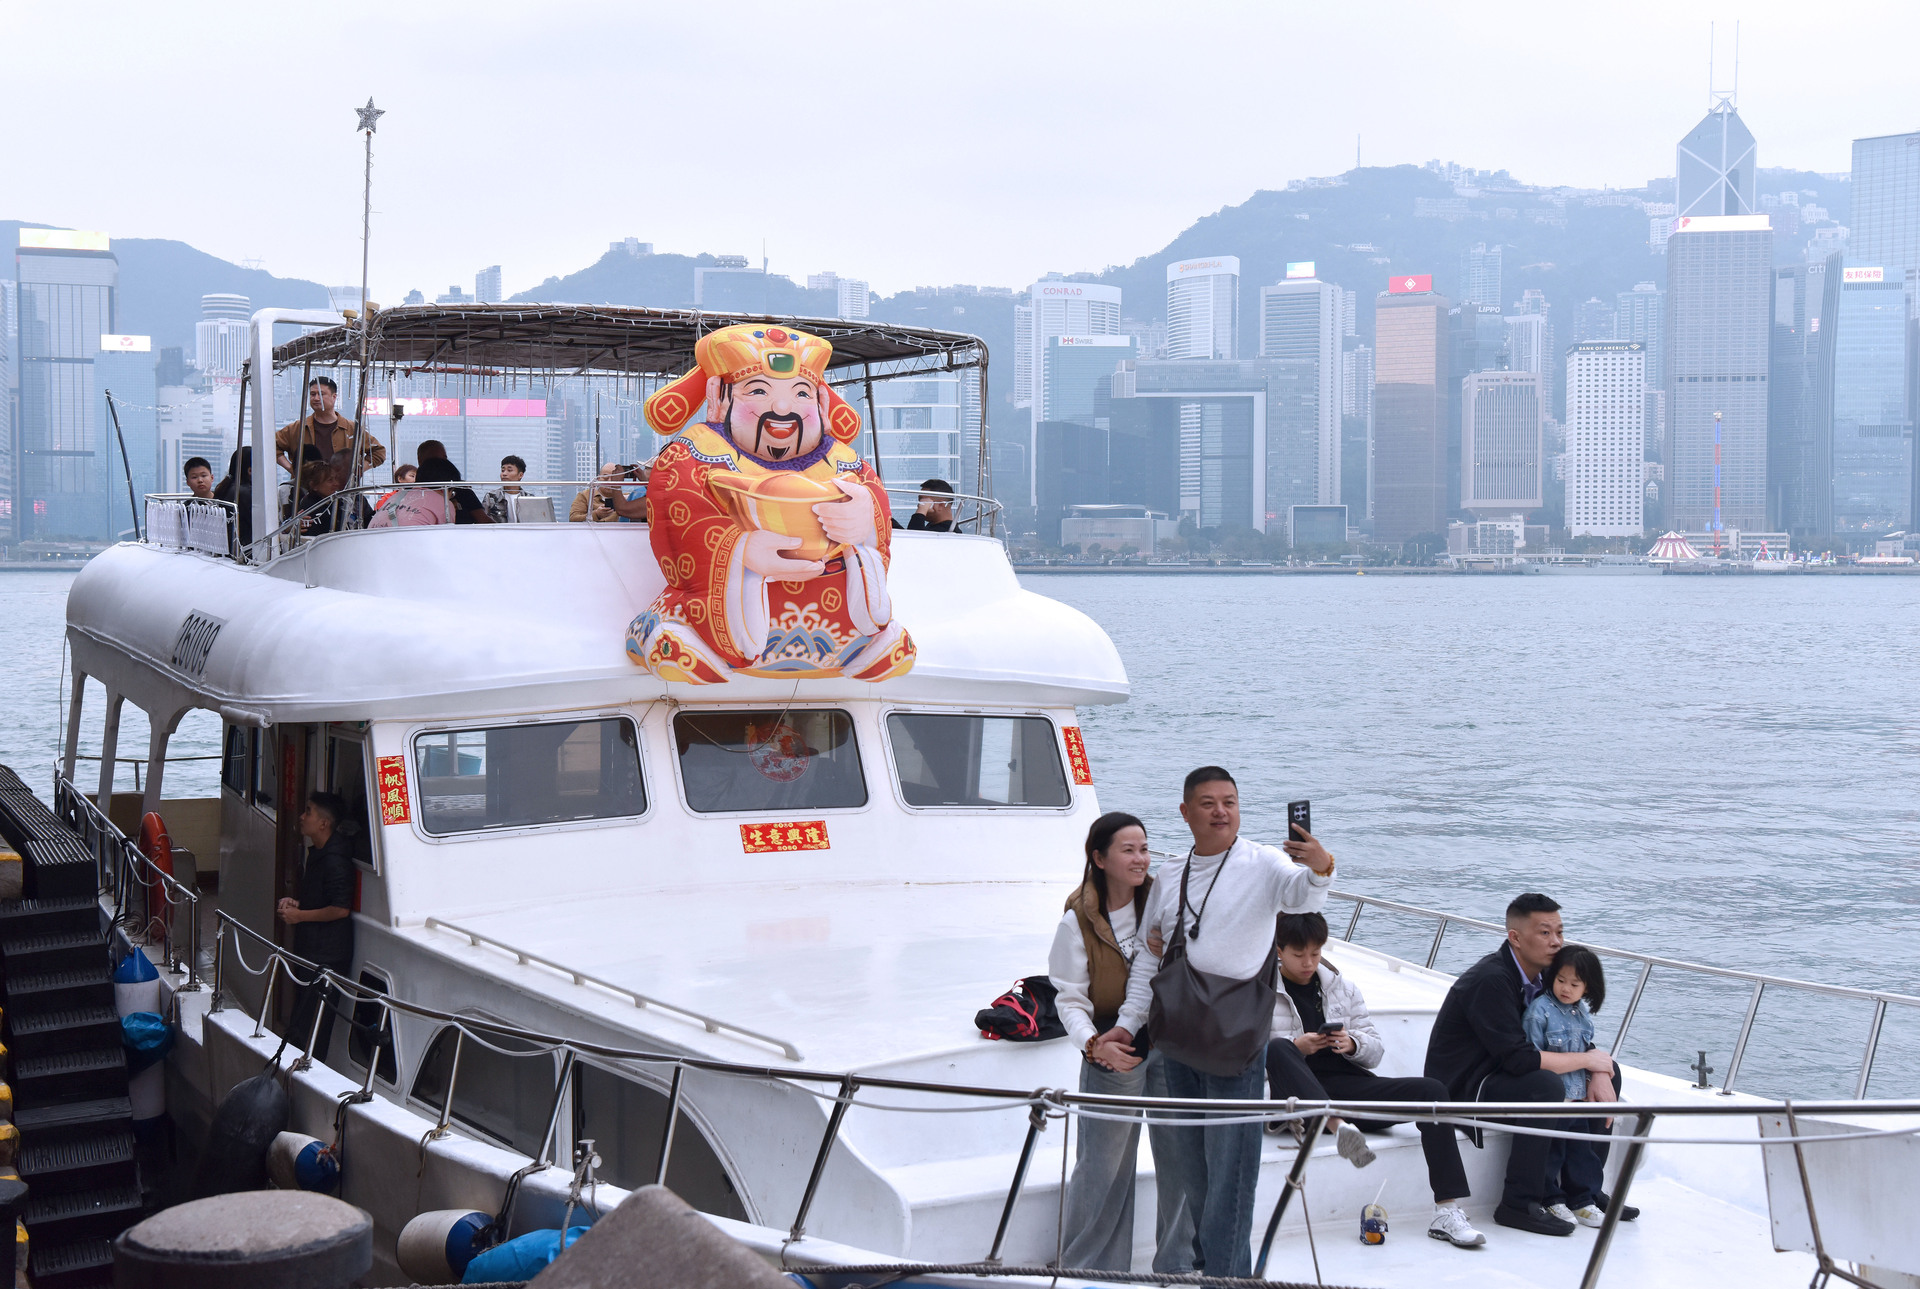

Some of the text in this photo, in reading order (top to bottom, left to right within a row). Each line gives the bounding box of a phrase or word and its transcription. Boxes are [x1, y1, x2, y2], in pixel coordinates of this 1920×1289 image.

[1845, 270, 1882, 279] 友邦保險
[1043, 287, 1083, 296] CONRAD
[1448, 308, 1461, 316] LIPPO
[1067, 731, 1088, 780] 生意興隆
[384, 761, 405, 819] 一帆風順
[749, 827, 821, 846] 生意興隆
